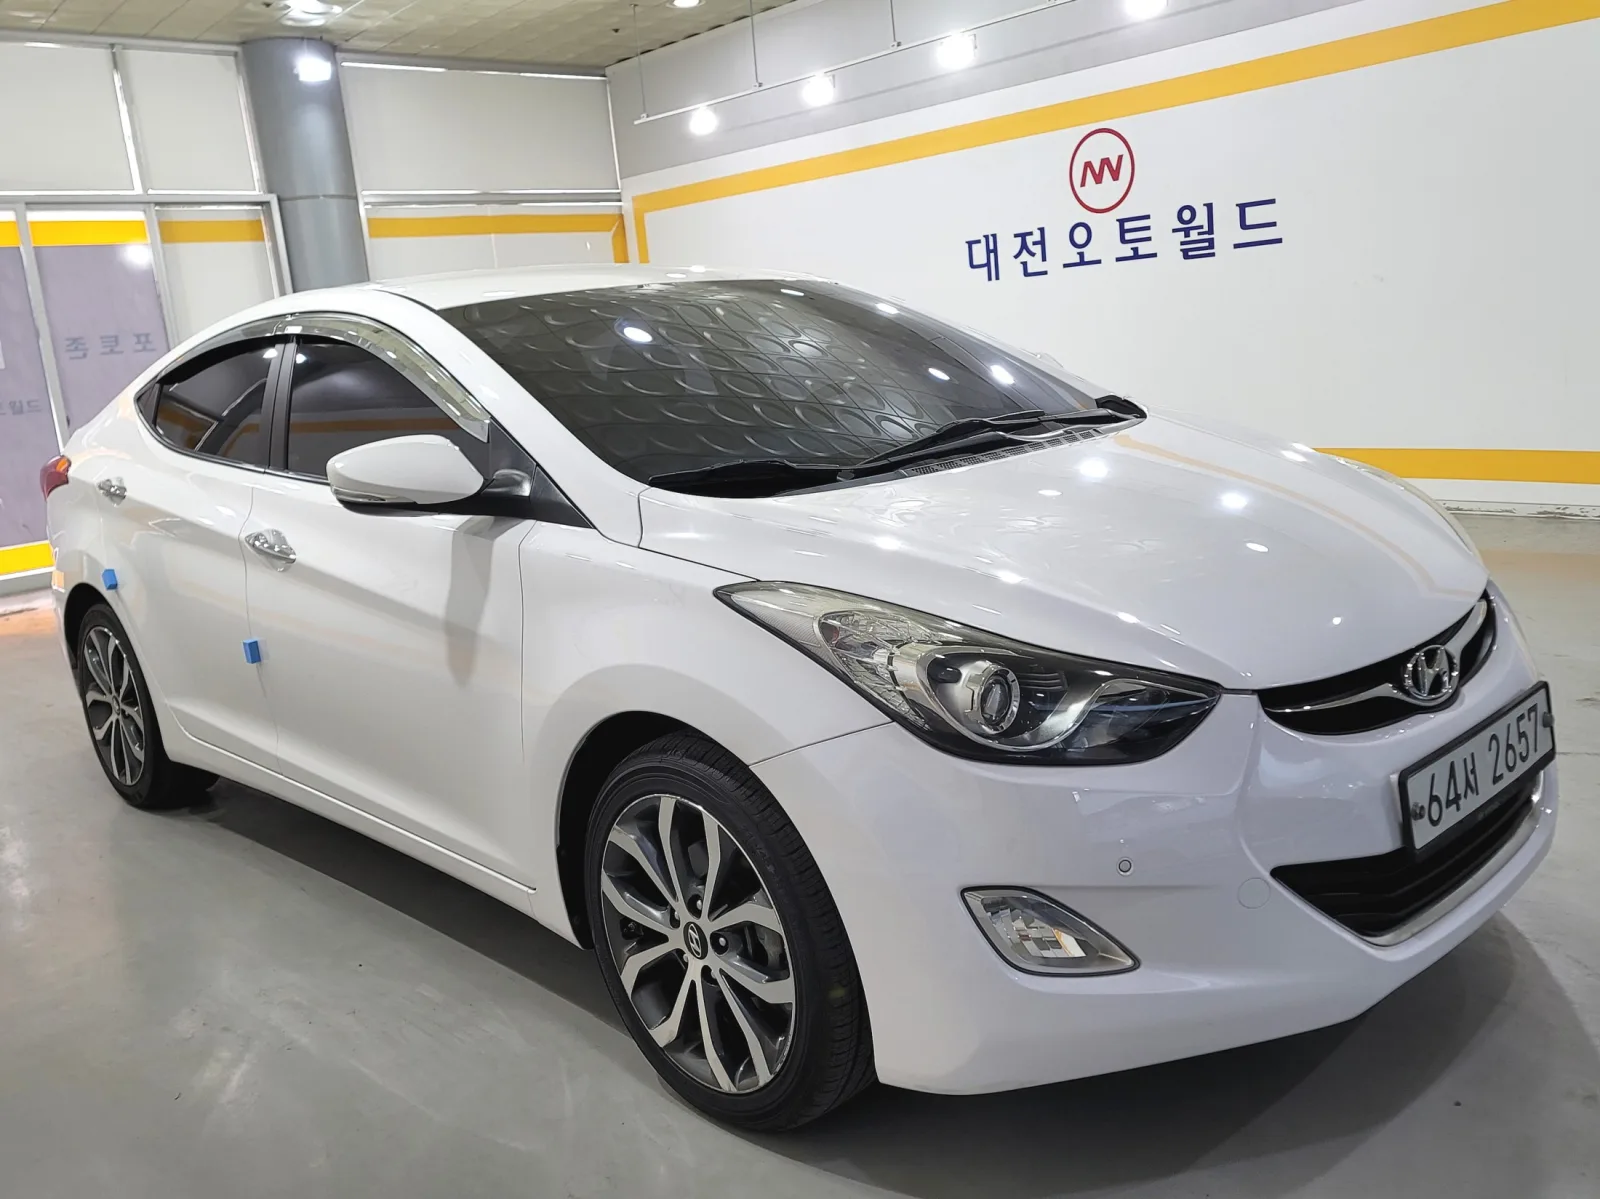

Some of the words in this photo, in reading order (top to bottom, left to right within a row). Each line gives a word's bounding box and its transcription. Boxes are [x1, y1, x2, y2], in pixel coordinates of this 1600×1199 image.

[965, 198, 1283, 282] 대전오토월드
[1427, 752, 1479, 827] 64서
[1488, 703, 1538, 785] 2657
